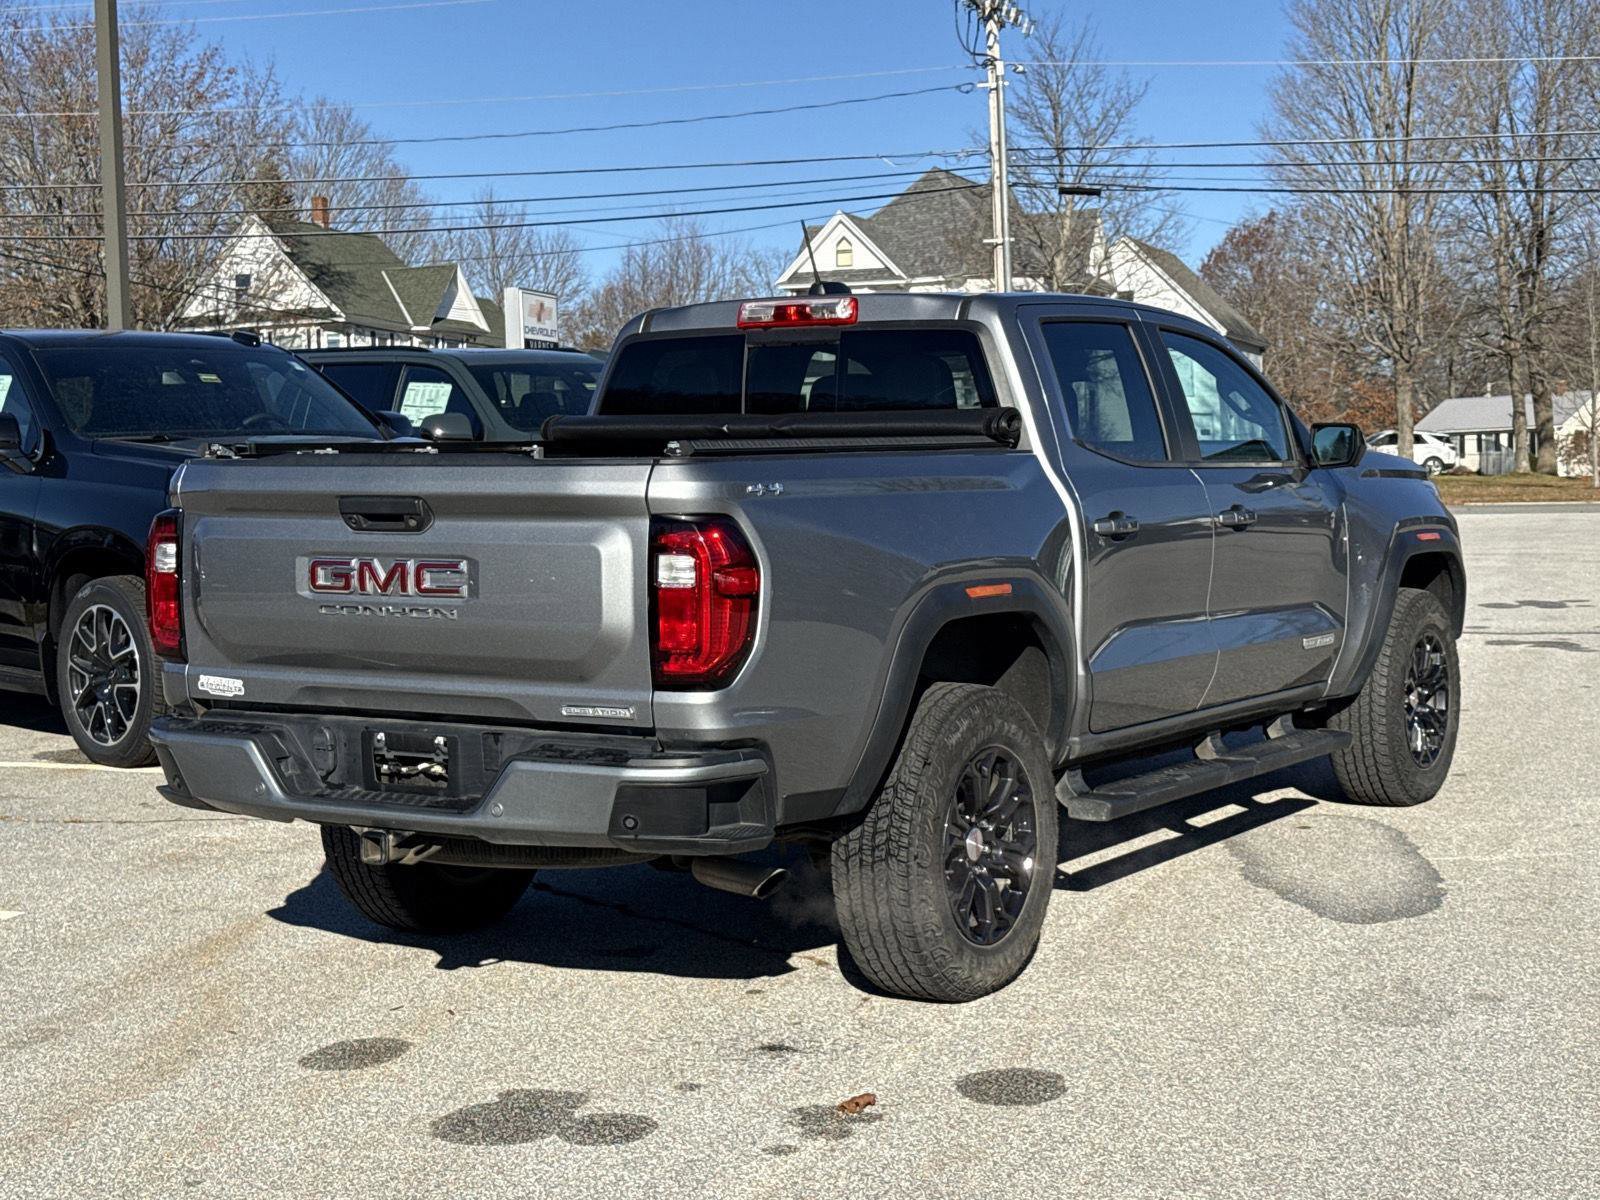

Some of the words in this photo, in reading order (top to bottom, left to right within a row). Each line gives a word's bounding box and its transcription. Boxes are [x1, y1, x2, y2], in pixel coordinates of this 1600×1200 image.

[524, 325, 558, 338] CHEVROLET
[309, 557, 468, 598] GMC
[318, 604, 458, 620] CANYON
